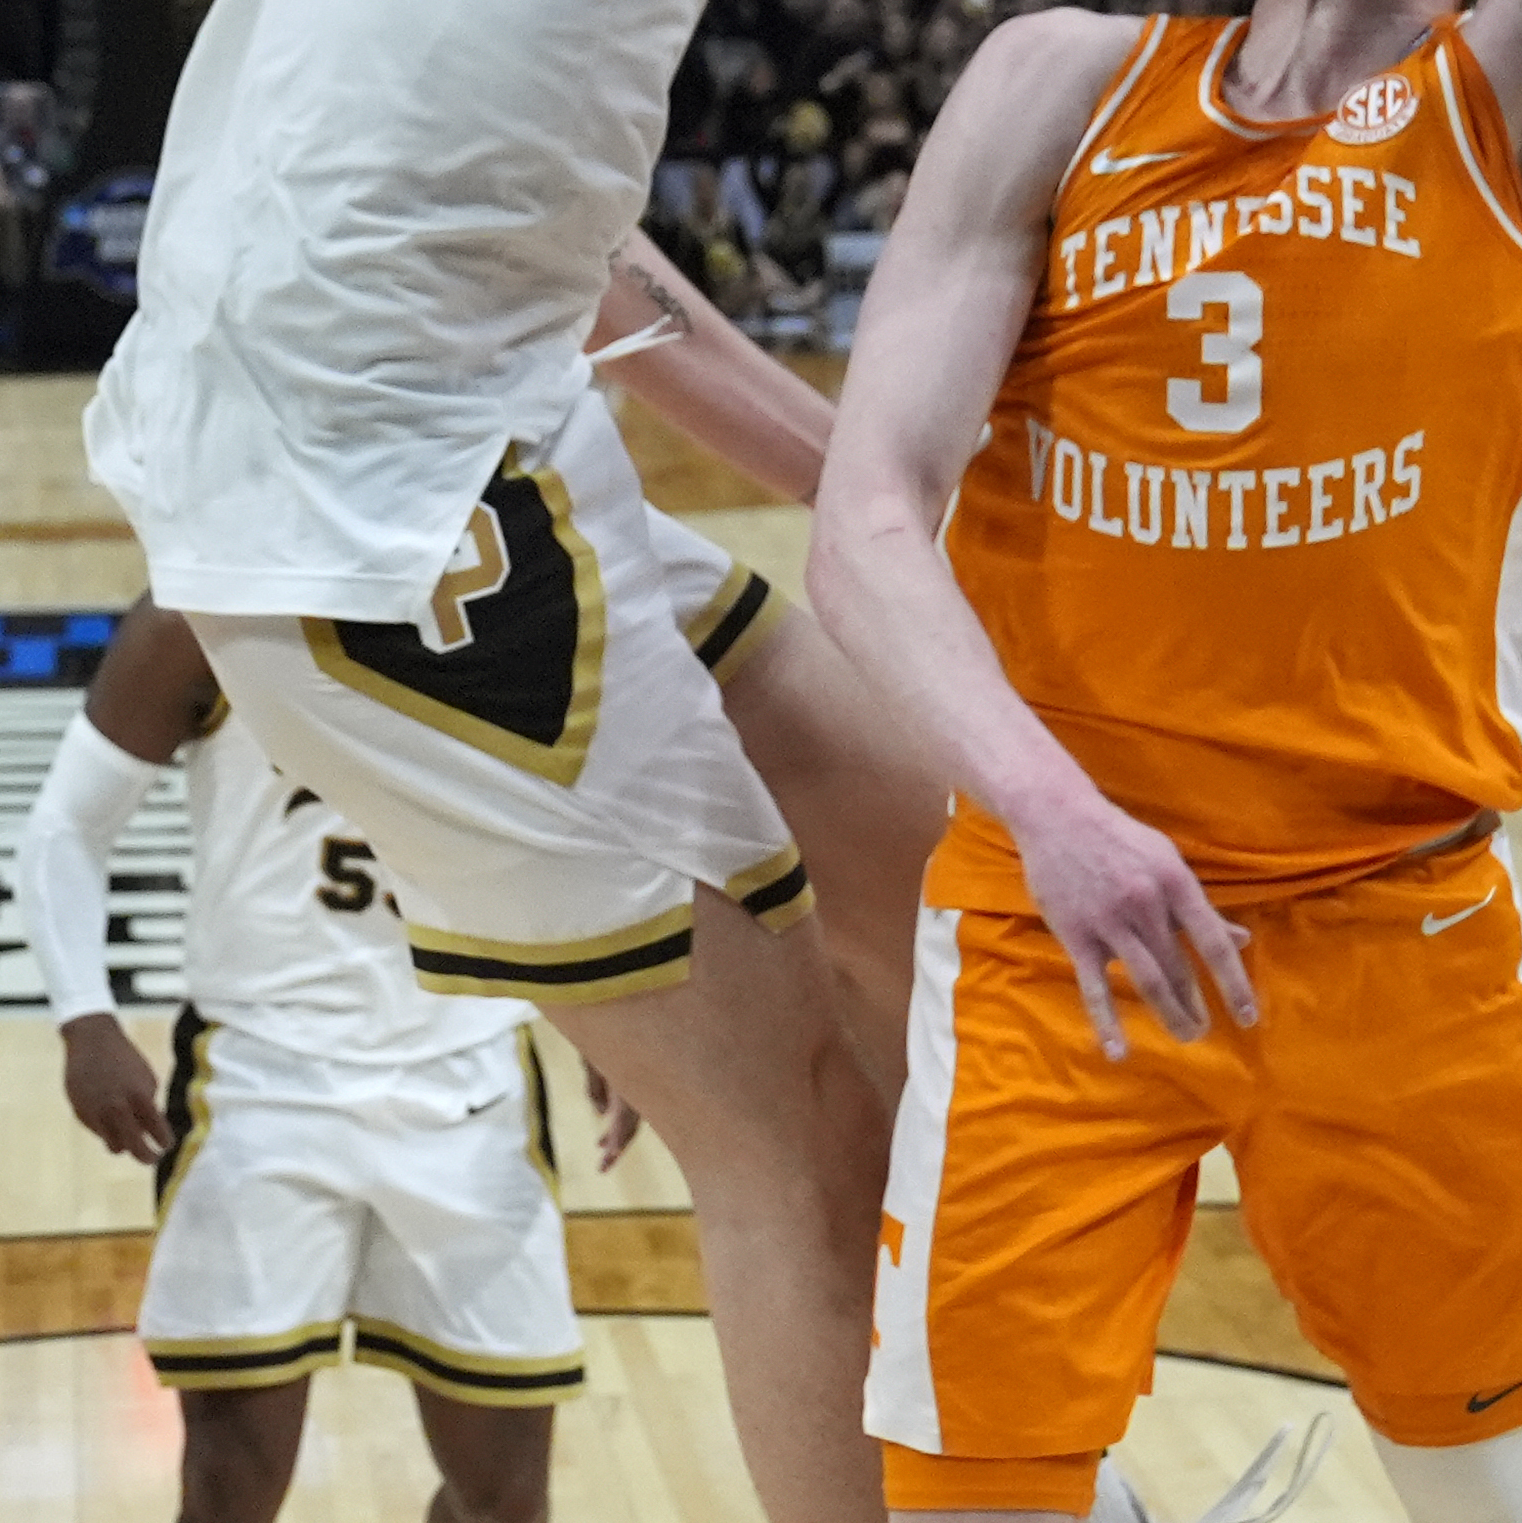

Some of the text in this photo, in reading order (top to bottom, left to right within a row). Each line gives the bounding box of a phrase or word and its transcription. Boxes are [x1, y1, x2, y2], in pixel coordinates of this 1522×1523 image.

[1345, 78, 1404, 127] SEC
[1165, 269, 1265, 434] 3
[1025, 417, 1426, 550] VOLUNTEERS
